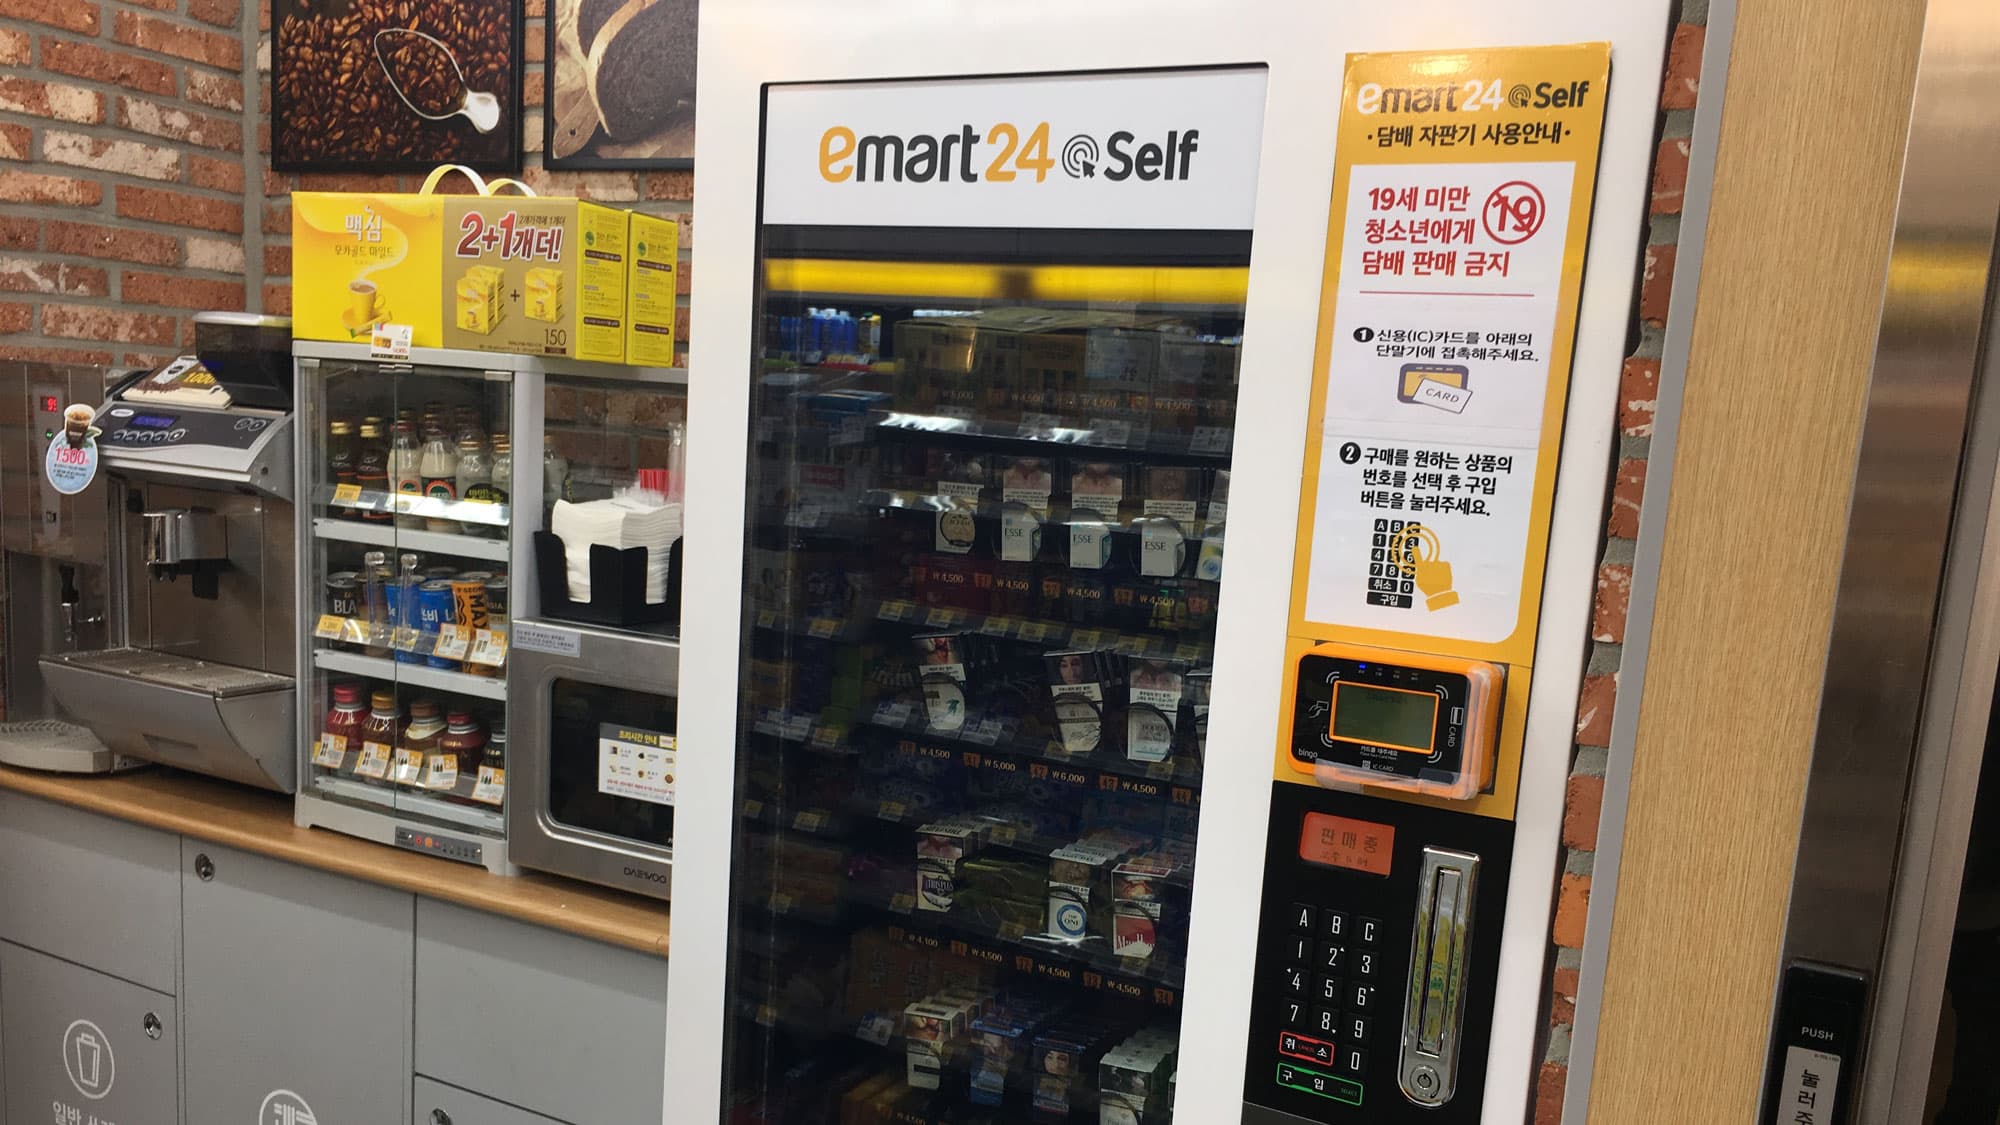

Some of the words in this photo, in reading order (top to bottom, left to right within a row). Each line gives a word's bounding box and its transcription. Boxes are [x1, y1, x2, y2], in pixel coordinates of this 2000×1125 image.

[1533, 81, 1590, 109] Self
[1418, 124, 1476, 147] 자판기
[1104, 129, 1199, 182] Self
[1368, 186, 1417, 212] 19세
[1423, 186, 1470, 212] 미만
[1492, 195, 1537, 232] 19
[345, 211, 383, 242] 맥심
[1365, 219, 1475, 246] 청소년에게
[1362, 252, 1404, 276] 담배
[1411, 252, 1456, 277] 판매
[1464, 252, 1510, 277] 금지
[544, 328, 567, 346] 150
[1377, 328, 1481, 346] 신용(IC)카드를
[1485, 332, 1533, 347] 아래의
[1376, 345, 1436, 360] 단말기에
[1440, 347, 1540, 362] 접촉해주세요.
[1425, 387, 1460, 404] CARD
[1363, 448, 1409, 467] 구매를
[1413, 450, 1461, 471] 원하는
[1464, 453, 1514, 474] 상품의
[1362, 468, 1407, 489] 번호를
[1411, 472, 1442, 491] 선택
[1445, 474, 1462, 492] 후
[1464, 476, 1497, 496] 구입
[1360, 490, 1405, 511] 버튼을
[1409, 492, 1491, 517] 눌러주세요.
[1005, 528, 1023, 537] ESSE
[1376, 521, 1385, 531] A
[1393, 522, 1400, 532] B
[1073, 535, 1093, 544] ESSE
[1145, 542, 1166, 551] ESSE
[1377, 535, 1382, 545] 1
[1408, 539, 1415, 548] 3
[1374, 550, 1381, 560] 4
[1407, 553, 1413, 562] 6
[1373, 565, 1380, 574] 7
[1389, 566, 1396, 576] 8
[1373, 579, 1392, 591] 취소
[1403, 583, 1410, 592] 0
[1380, 594, 1399, 606] 구입
[1447, 726, 1457, 748] CARD
[1298, 748, 1318, 759] bingo
[623, 866, 667, 884] DAEWOO
[1299, 908, 1308, 927] A
[1332, 915, 1341, 934] B
[1364, 922, 1374, 942] C
[1298, 940, 1303, 958] 1
[1328, 947, 1337, 966] 2
[1361, 955, 1371, 974] 3
[1292, 972, 1300, 991] 4
[1324, 979, 1333, 998] 5
[1357, 987, 1366, 1006] 6
[1290, 1004, 1299, 1023] 7
[1321, 1011, 1331, 1030] 8
[1354, 1020, 1364, 1038] 9
[1801, 1026, 1834, 1041] PUSH
[1350, 1051, 1360, 1070] 0
